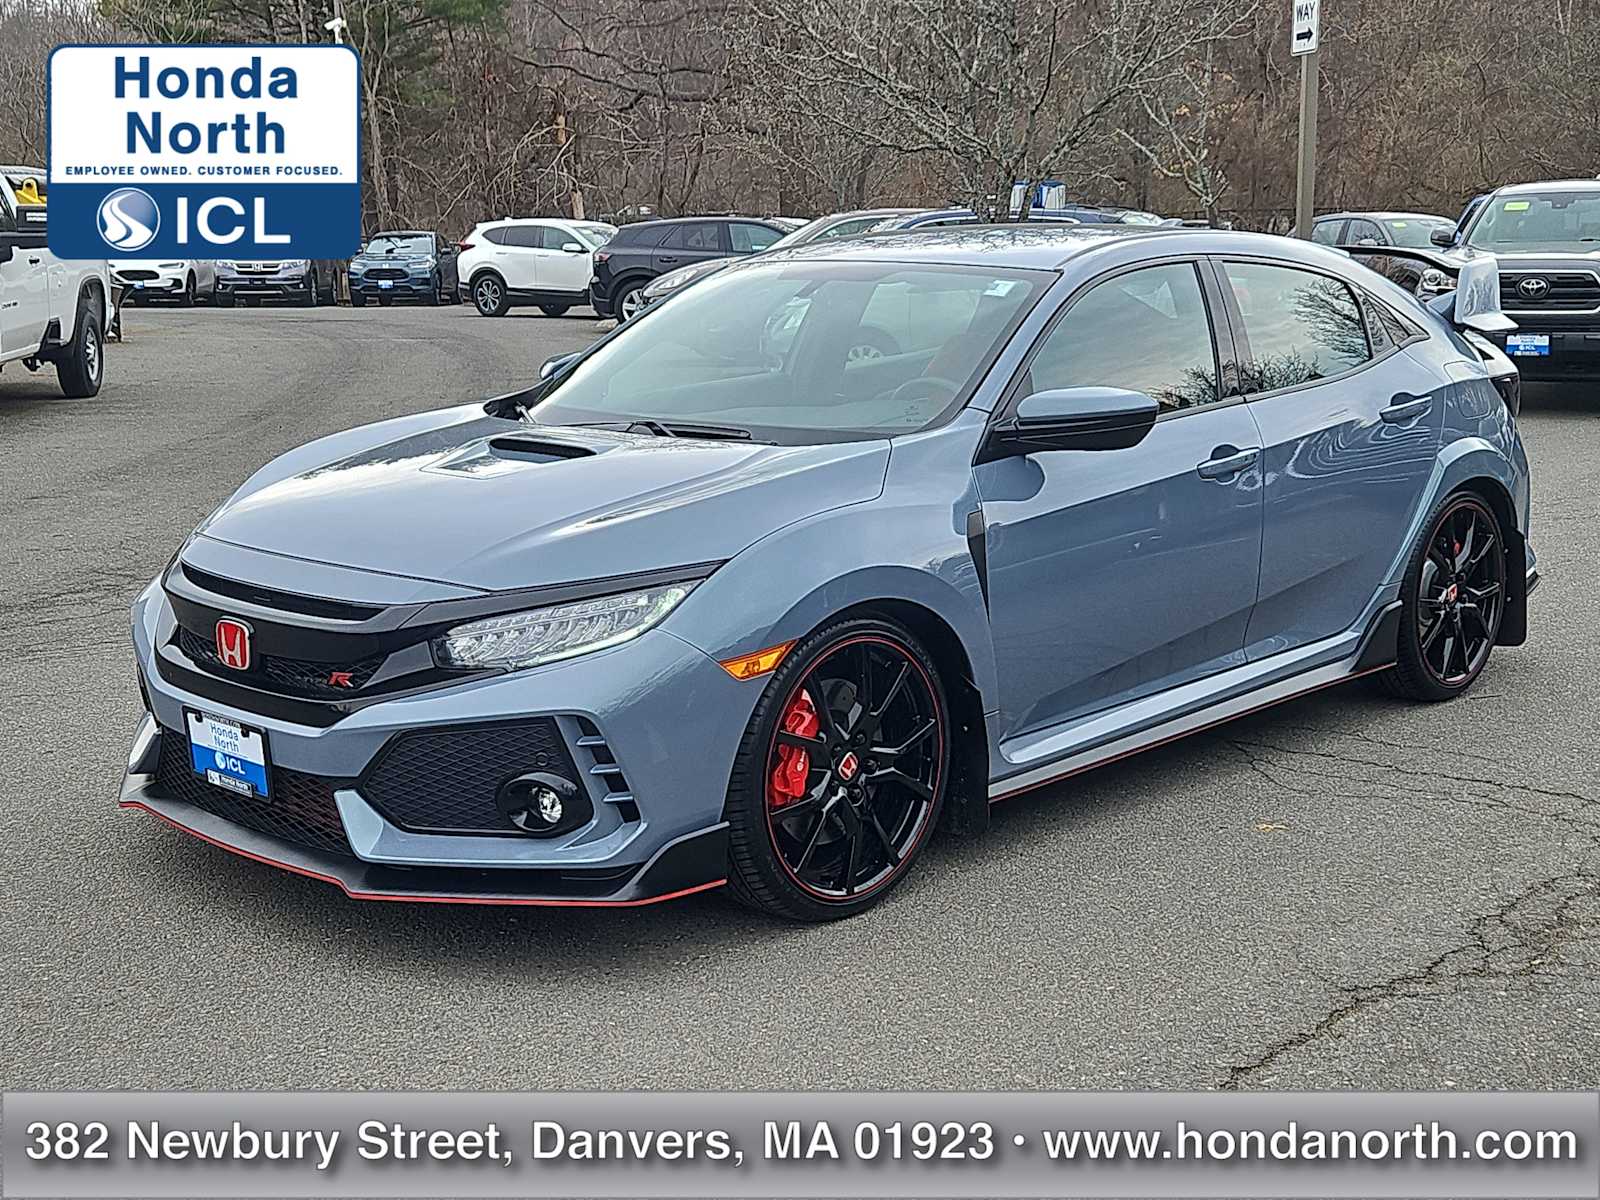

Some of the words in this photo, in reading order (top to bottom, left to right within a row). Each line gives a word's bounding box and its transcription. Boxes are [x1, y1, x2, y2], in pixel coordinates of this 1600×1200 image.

[1296, 2, 1315, 22] WAY
[210, 723, 239, 741] Honda
[214, 735, 240, 753] North
[225, 756, 246, 775] ICL
